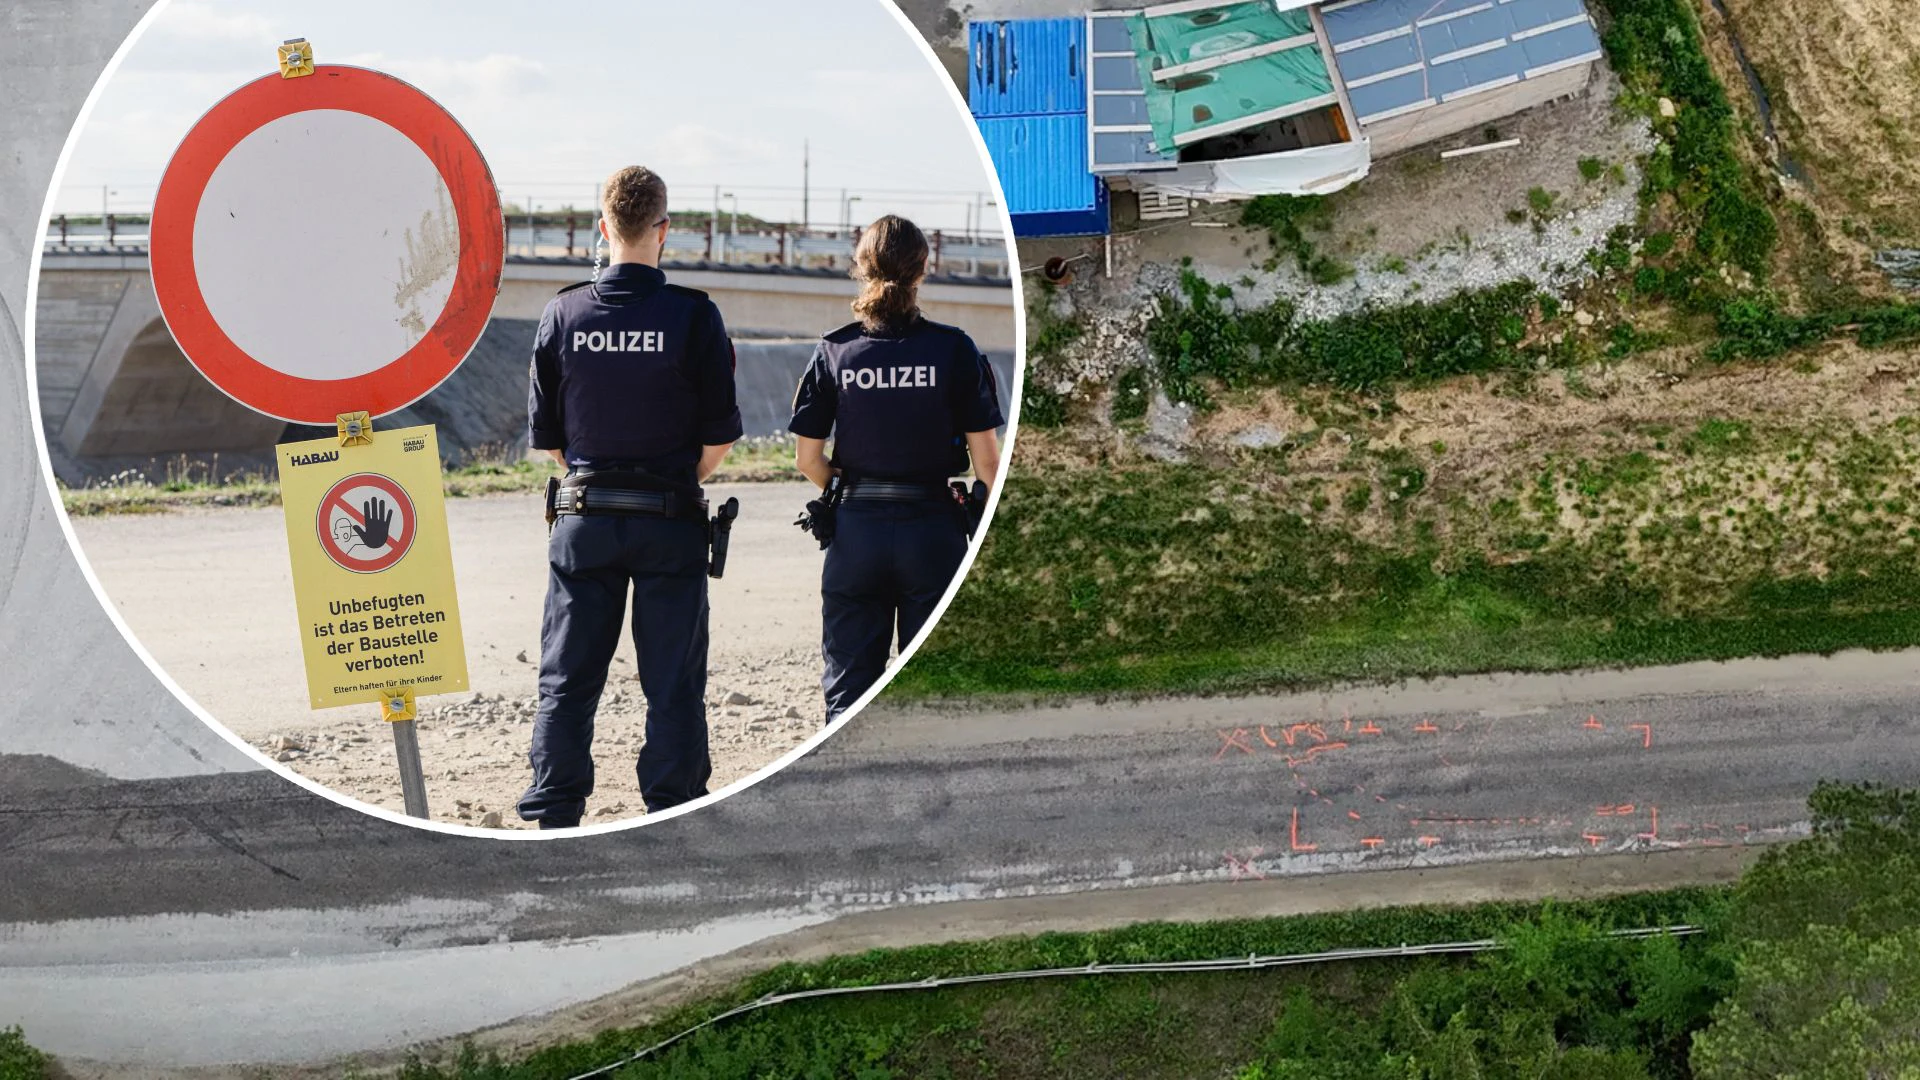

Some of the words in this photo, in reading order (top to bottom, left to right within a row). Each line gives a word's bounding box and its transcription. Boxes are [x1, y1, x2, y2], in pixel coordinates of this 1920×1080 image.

[573, 331, 664, 353] POLIZEI
[841, 366, 936, 390] POLIZEI
[403, 439, 425, 448] HABAU
[403, 444, 425, 453] GROUP
[291, 450, 340, 467] HABAU
[329, 593, 425, 615] Unbefugten
[313, 623, 335, 638] ist
[339, 620, 368, 635] das
[372, 610, 446, 631] Betreten
[327, 640, 355, 656] der
[359, 630, 438, 652] Baustelle
[345, 649, 425, 673] verboten!
[333, 685, 358, 695] Eltern
[359, 681, 385, 691] haften
[386, 679, 398, 688] für
[399, 677, 415, 687] ihre
[416, 674, 443, 685] Kinder
